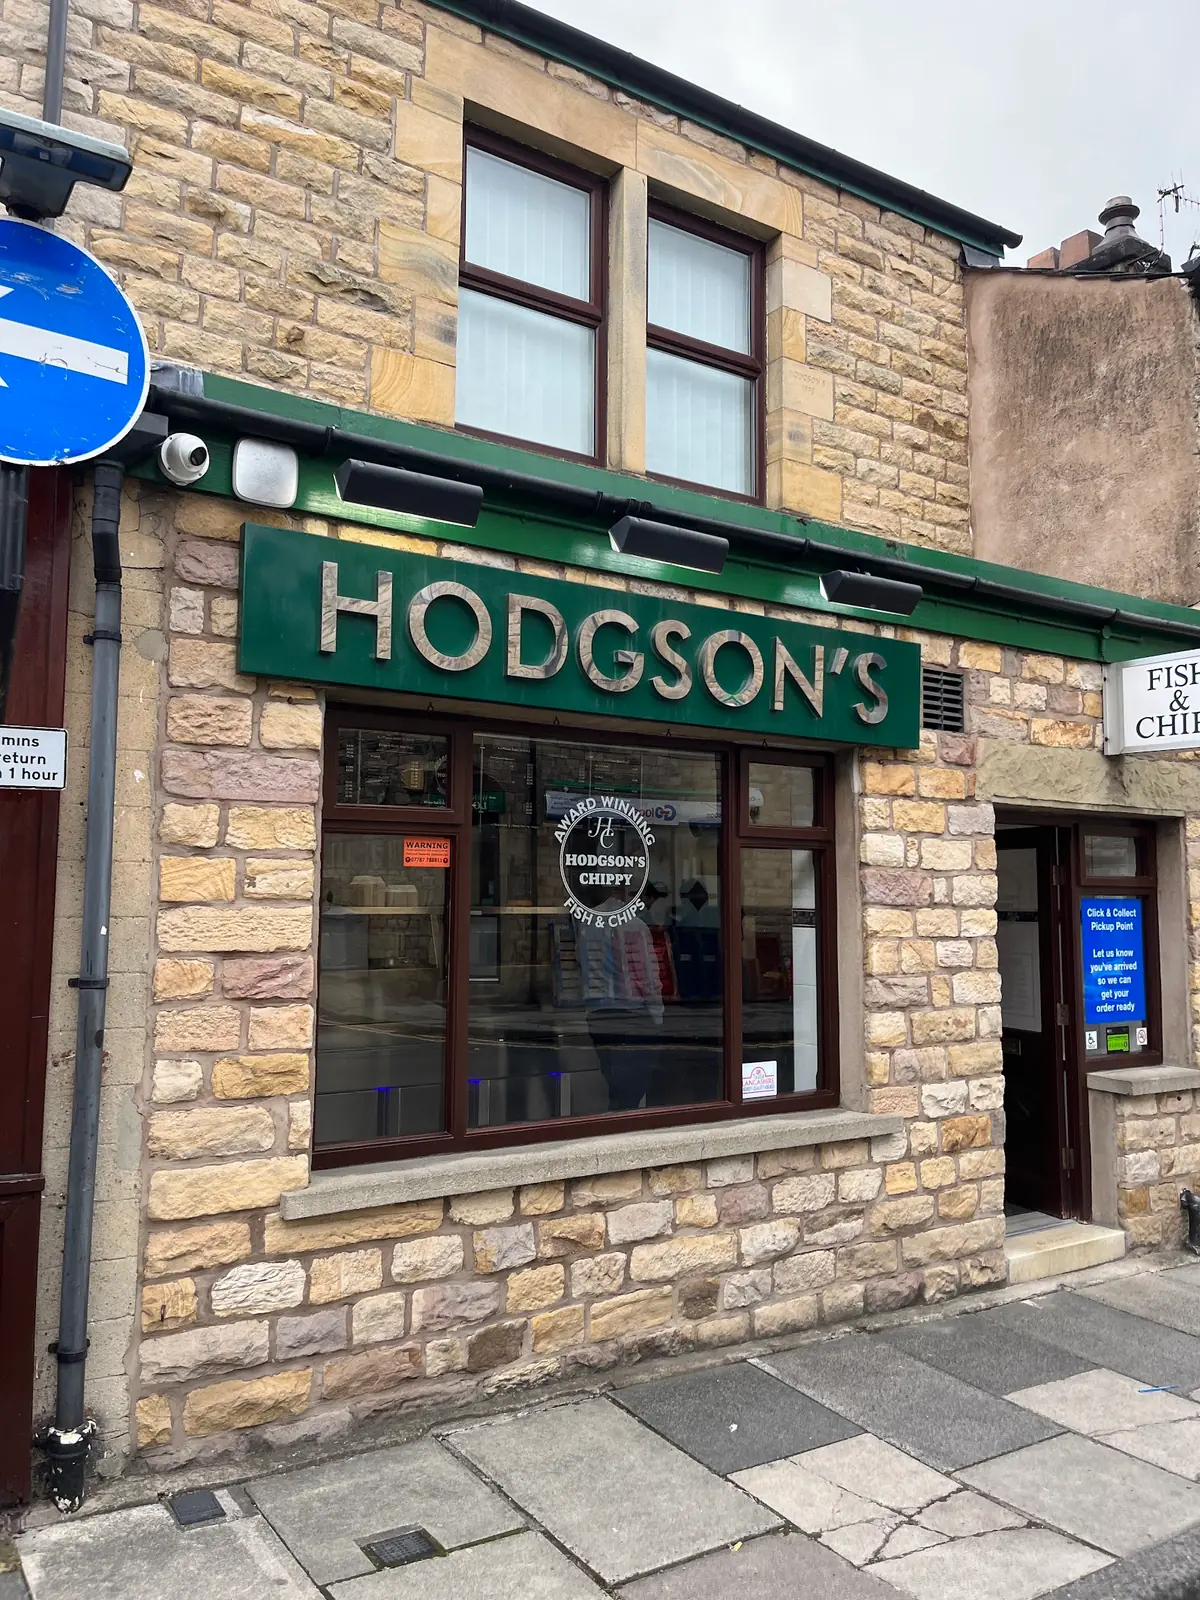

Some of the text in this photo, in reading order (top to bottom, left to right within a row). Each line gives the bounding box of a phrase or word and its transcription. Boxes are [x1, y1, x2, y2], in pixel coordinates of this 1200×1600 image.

[318, 560, 888, 724] HODGSON'S
[1169, 689, 1190, 712] &
[2, 736, 40, 747] mins
[0, 752, 46, 765] eturn
[9, 767, 15, 779] 1
[22, 767, 58, 781] hour
[554, 795, 657, 847] AWARD WINNING
[405, 841, 449, 850] WARNING
[565, 853, 646, 868] HODGSON'S
[579, 872, 633, 886] CHIPPY
[563, 897, 646, 928] FISH & CHIPS
[1087, 908, 1137, 918] Click & Collect
[1091, 922, 1134, 933] Pickup Point
[1093, 948, 1134, 958] Let us know
[1090, 961, 1138, 974] you've arrived
[1098, 976, 1132, 986] so we can
[1101, 989, 1130, 1001] get your
[1096, 1001, 1136, 1013] order ready
